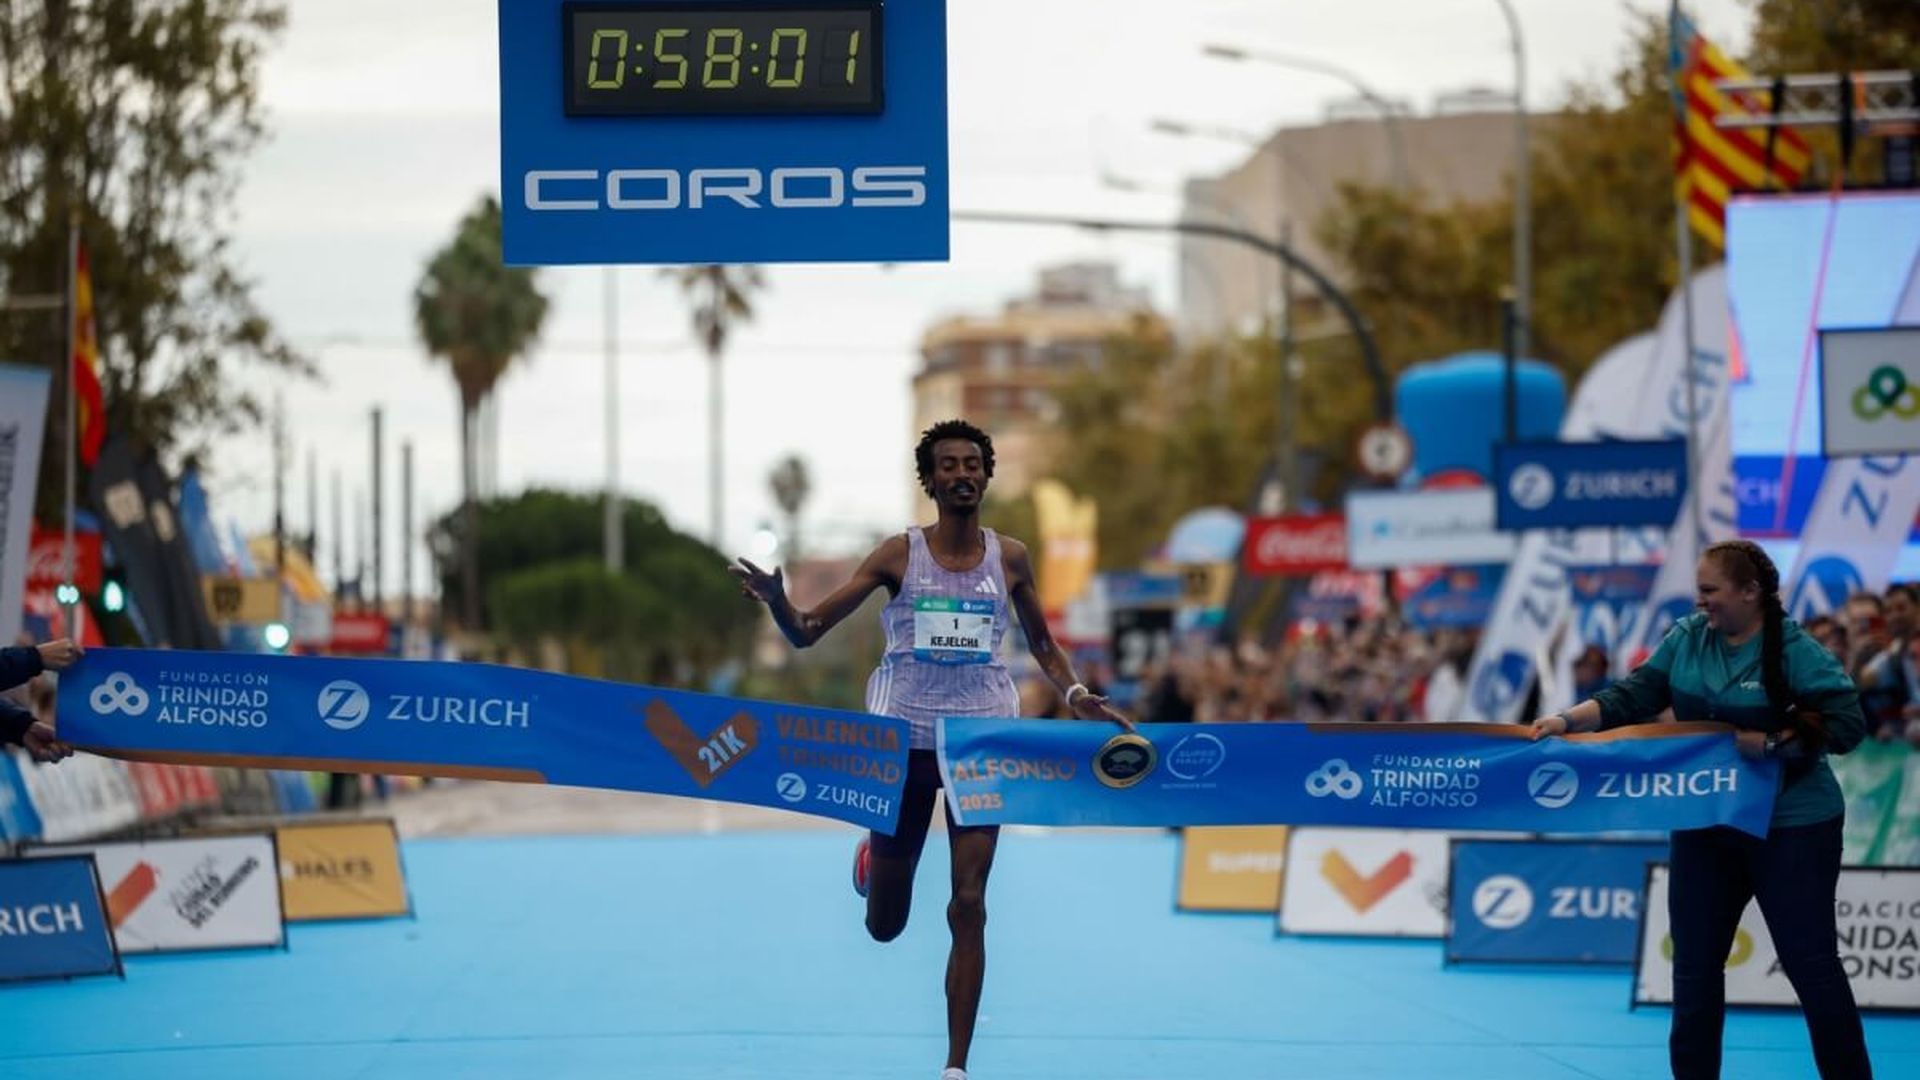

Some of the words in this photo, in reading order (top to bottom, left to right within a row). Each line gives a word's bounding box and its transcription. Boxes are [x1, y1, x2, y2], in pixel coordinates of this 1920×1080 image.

[587, 28, 860, 89] 0:58:01
[524, 166, 926, 210] COROS
[1565, 470, 1676, 499] ZURICH
[952, 618, 959, 630] 1
[930, 636, 979, 648] KEJELCHA
[158, 685, 268, 708] TRINIDAD
[387, 694, 530, 728] ZURICH
[157, 706, 268, 728] ALFONSO
[774, 713, 898, 752] VALENCIA
[698, 724, 747, 774] 21K
[777, 745, 900, 785] TRINIDAD
[953, 756, 1077, 782] ALFONSO
[1371, 768, 1481, 790] TRINIDAD
[1596, 768, 1738, 798] ZURICH
[816, 784, 891, 817] ZURICH
[1370, 789, 1478, 808] ALFONSO
[1548, 886, 1644, 920] ZUR
